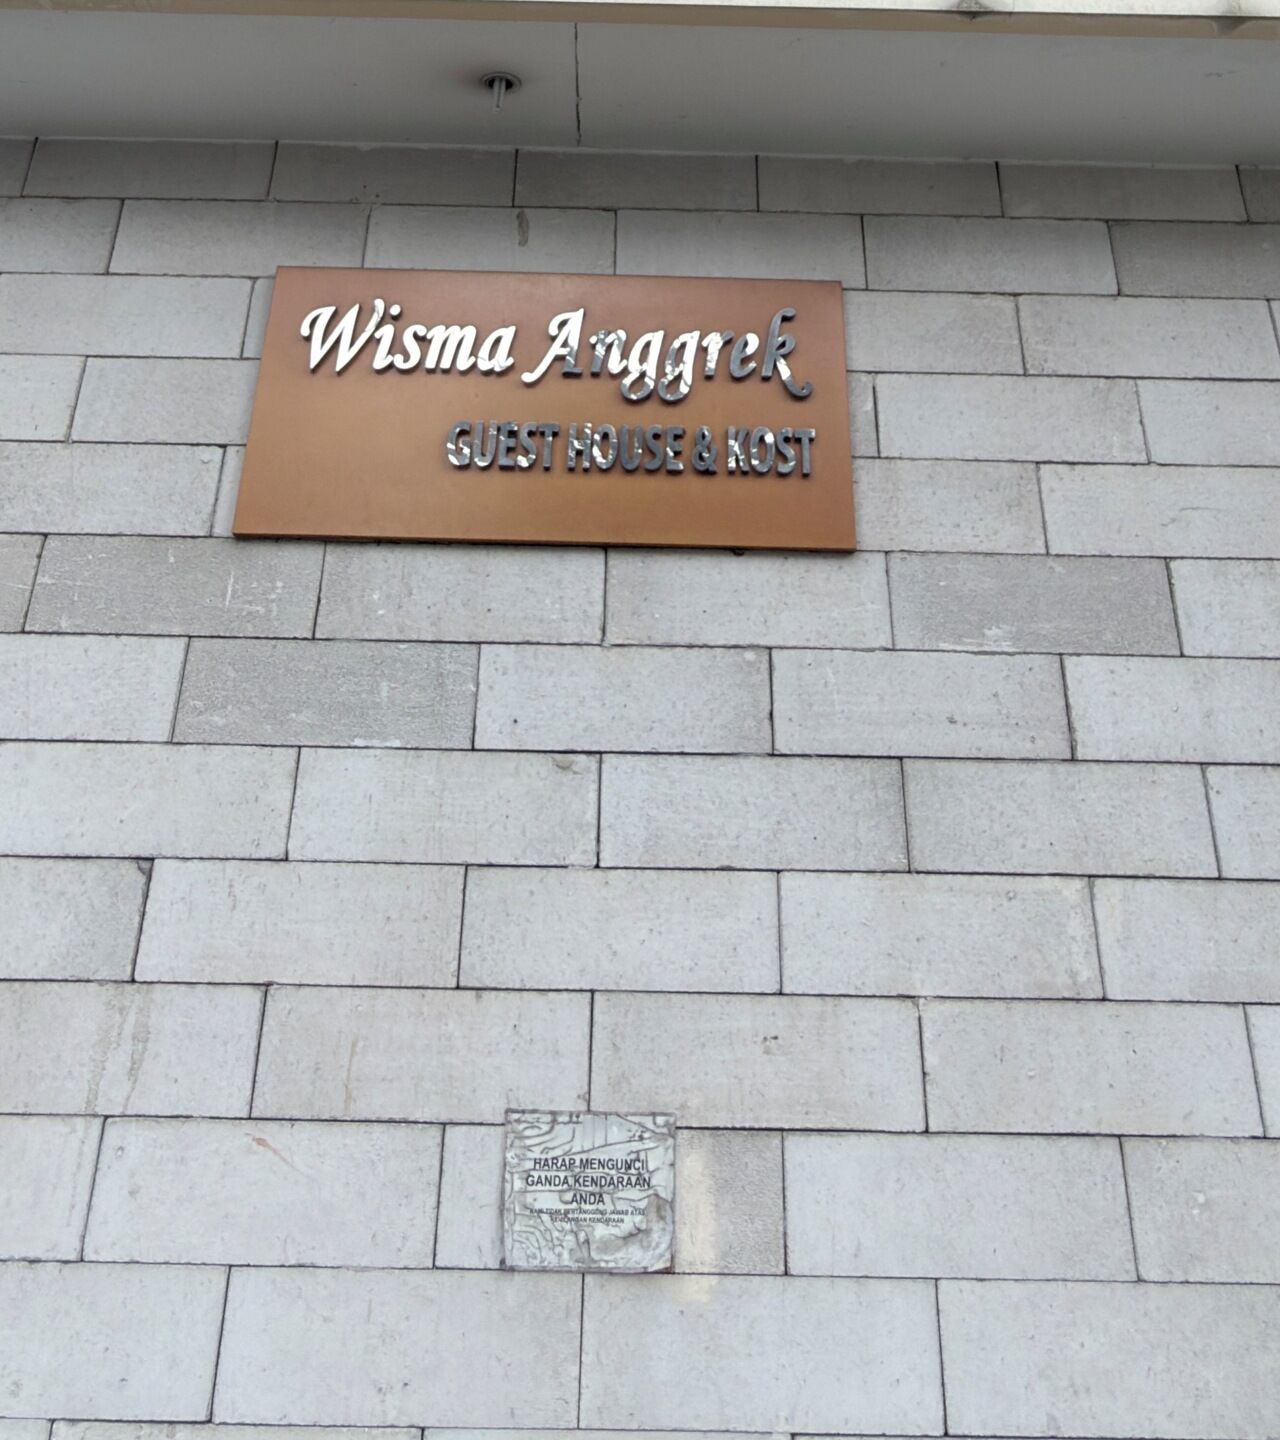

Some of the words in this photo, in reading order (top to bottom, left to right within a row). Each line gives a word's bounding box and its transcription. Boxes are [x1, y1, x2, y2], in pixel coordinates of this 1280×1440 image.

[300, 298, 517, 374] Wisma
[521, 306, 813, 404] Anggrek
[445, 420, 560, 471] GUEST
[567, 422, 685, 473] HOUSE
[693, 425, 717, 475] &
[726, 426, 816, 478] KOST
[533, 1157, 576, 1171] HARAP
[579, 1158, 645, 1172] MENGUNCI
[526, 1174, 570, 1187] GANDA
[573, 1175, 651, 1188] KENDARAAN
[570, 1193, 605, 1206] ANDA
